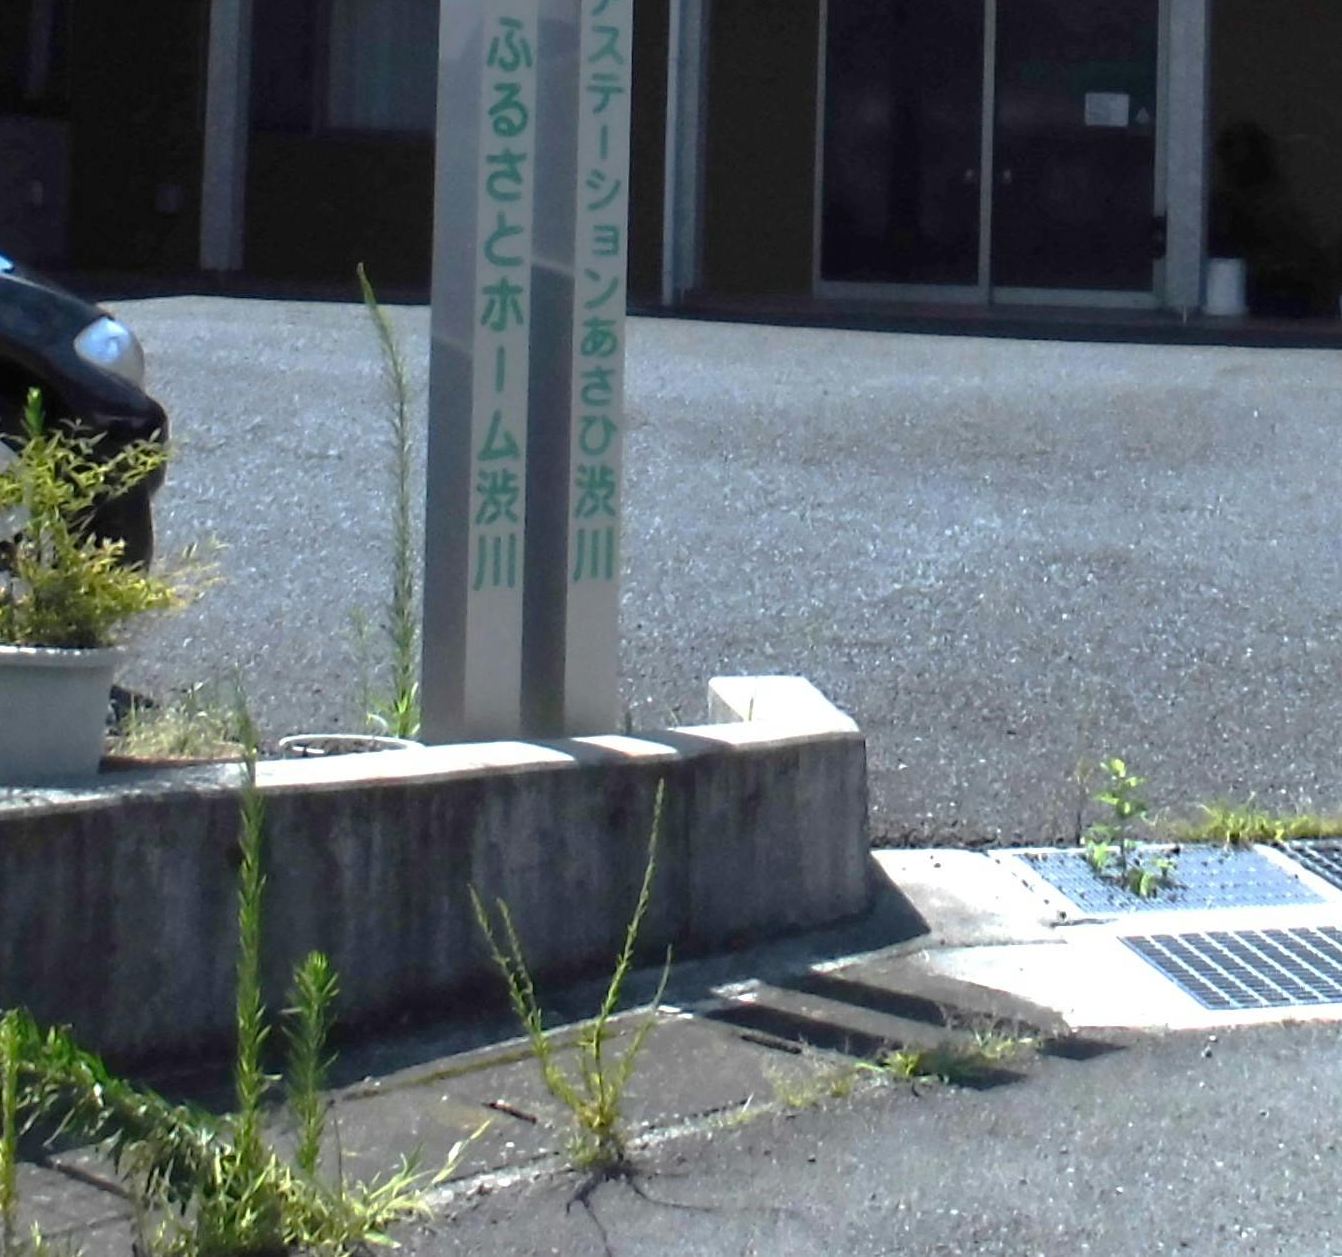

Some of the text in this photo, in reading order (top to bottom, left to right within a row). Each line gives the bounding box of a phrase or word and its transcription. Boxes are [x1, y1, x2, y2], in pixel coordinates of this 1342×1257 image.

[472, 16, 533, 592] ふるさとホーム渋川
